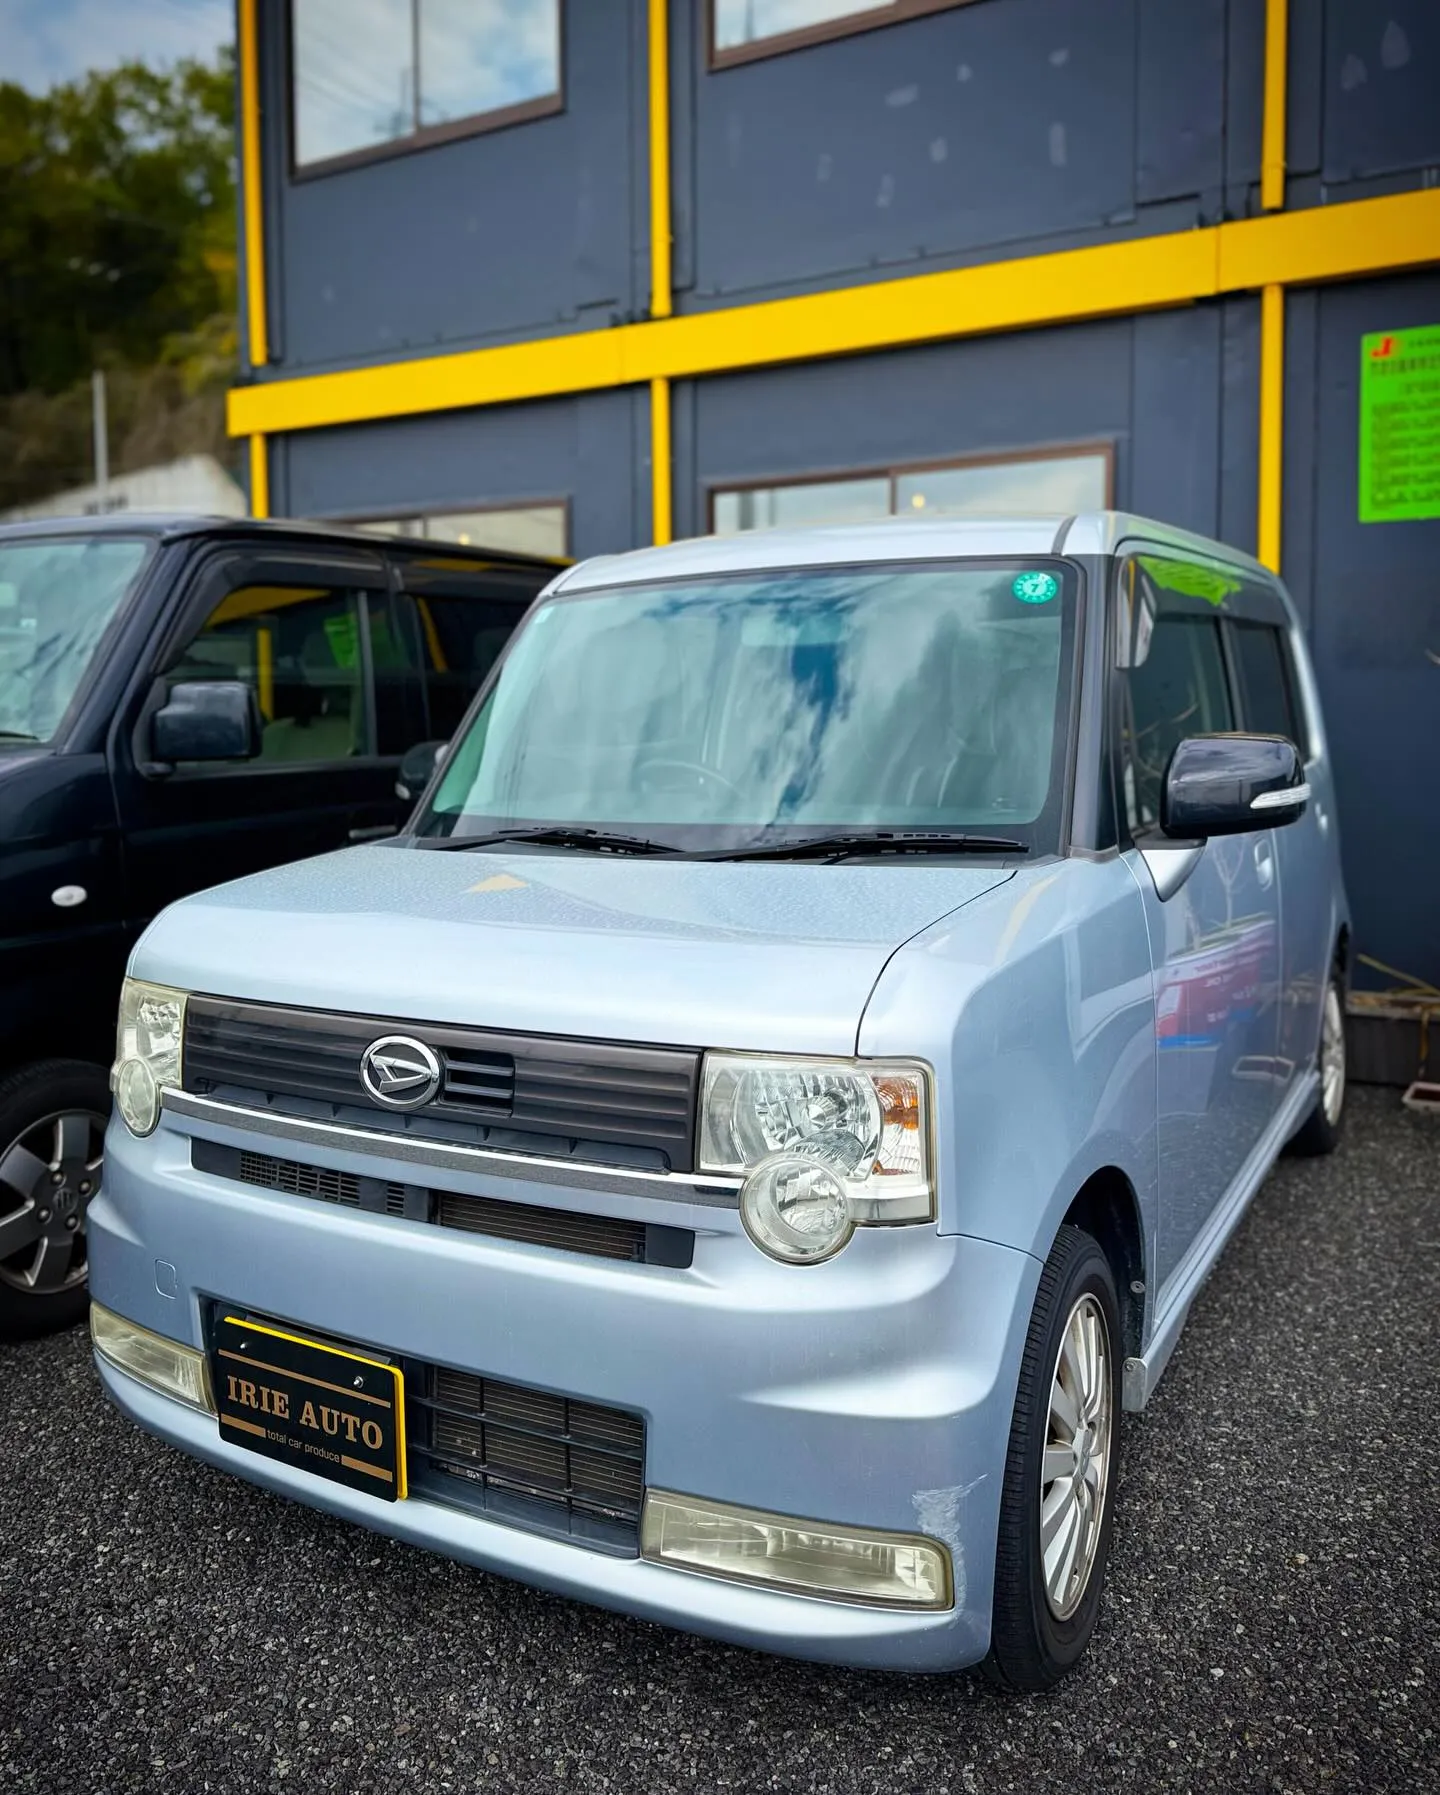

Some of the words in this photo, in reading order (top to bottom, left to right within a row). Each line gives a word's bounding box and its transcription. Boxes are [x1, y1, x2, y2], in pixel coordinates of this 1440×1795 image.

[227, 1375, 290, 1420] IRIE
[299, 1400, 384, 1450] AUTO
[266, 1429, 287, 1444] total
[288, 1438, 302, 1449] car
[304, 1444, 340, 1463] produce
